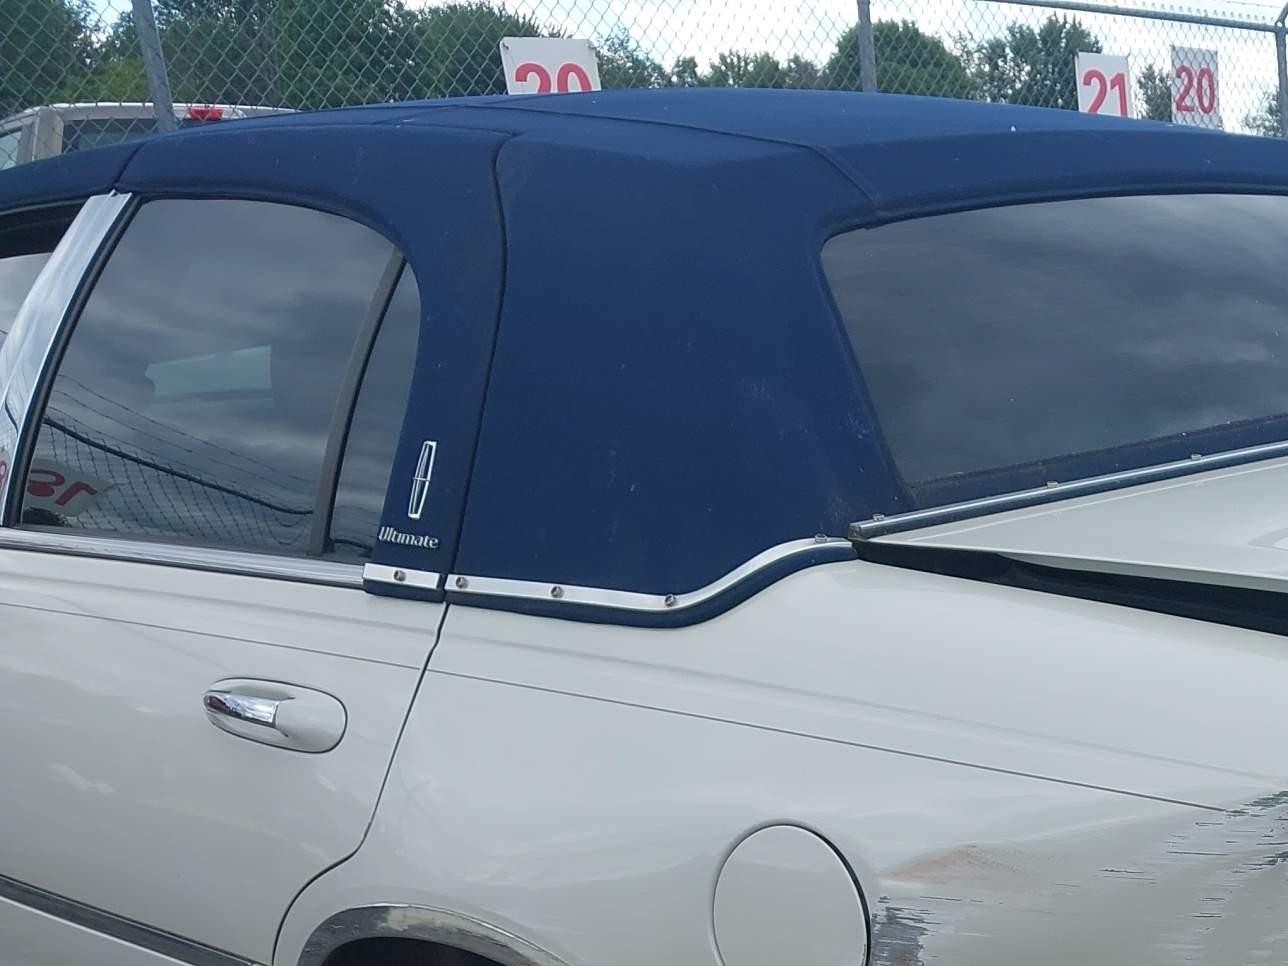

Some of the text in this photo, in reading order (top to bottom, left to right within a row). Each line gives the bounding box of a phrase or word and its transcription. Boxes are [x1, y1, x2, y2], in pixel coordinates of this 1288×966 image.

[1083, 69, 1128, 117] 21
[1176, 65, 1216, 114] 20
[378, 526, 439, 549] Ultimate
